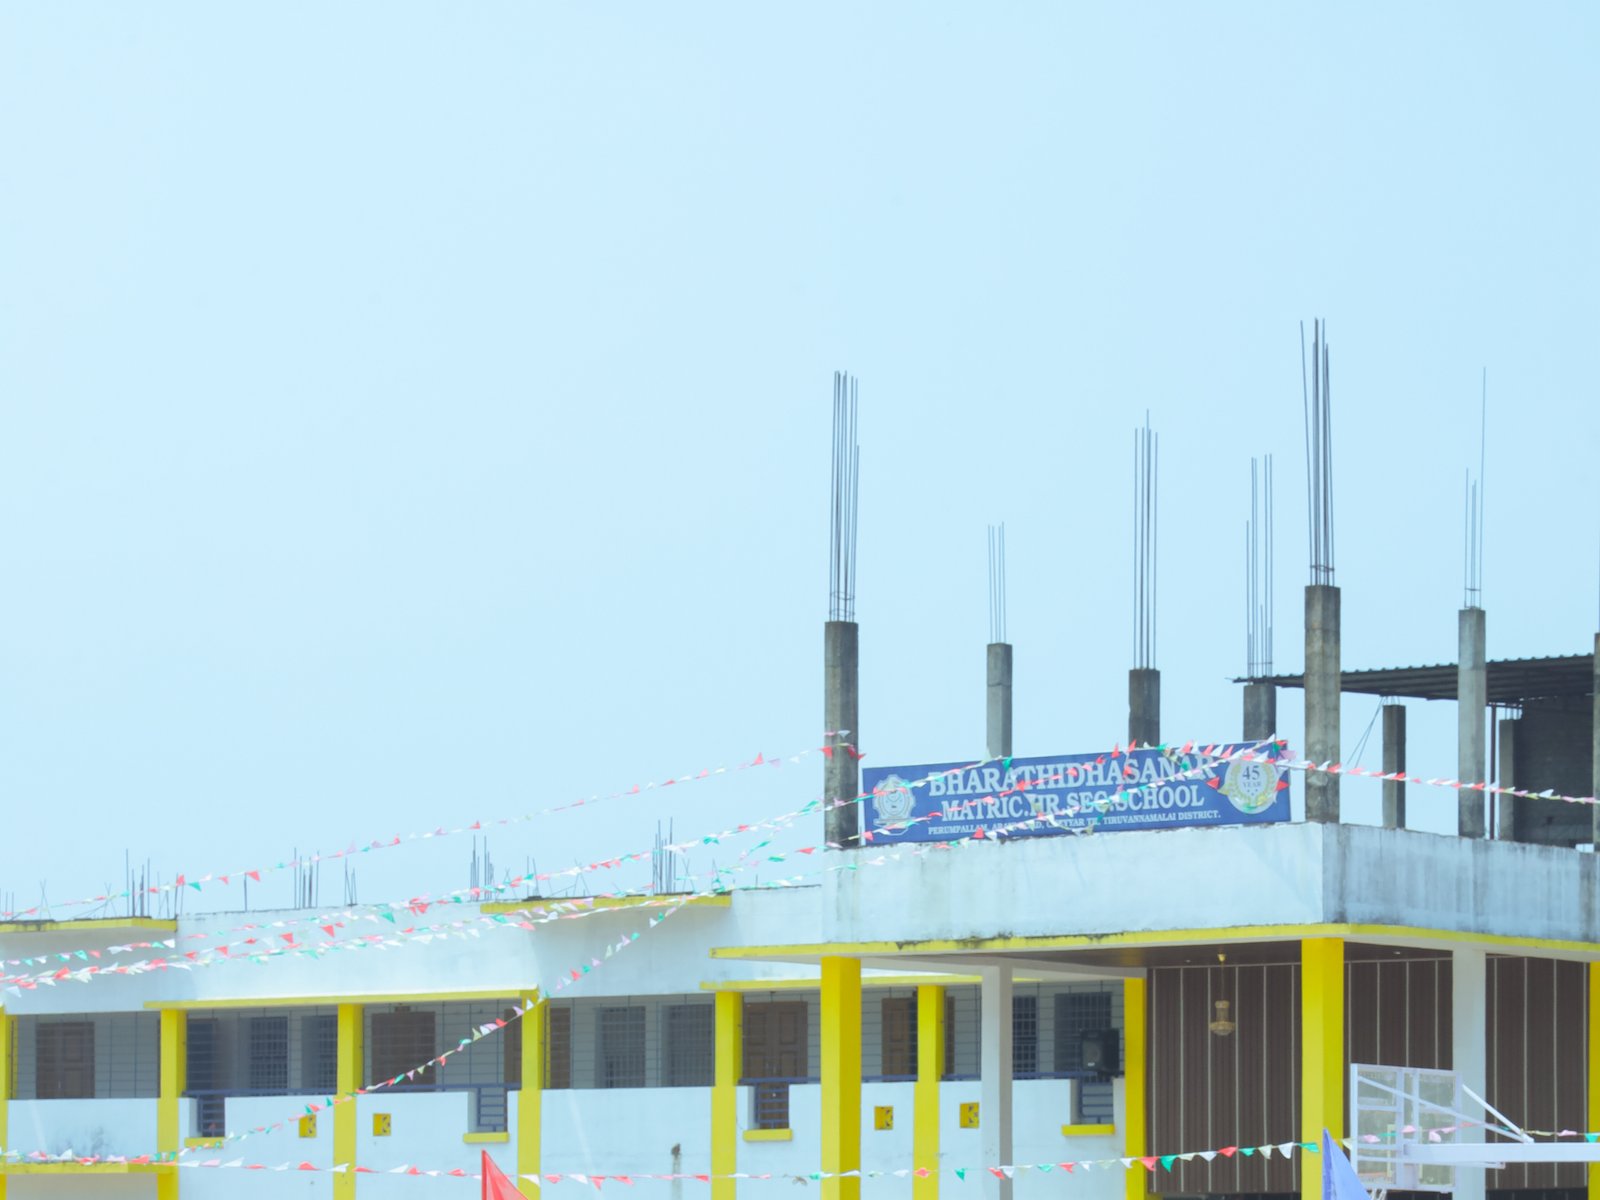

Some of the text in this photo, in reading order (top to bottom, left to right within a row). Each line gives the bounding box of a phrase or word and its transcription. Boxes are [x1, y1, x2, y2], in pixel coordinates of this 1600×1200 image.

[928, 755, 1217, 796] BHARATHIDHASANAR
[1242, 765, 1260, 780] 45
[1103, 812, 1176, 825] TIRUVANNAMALAI
[1178, 810, 1221, 820] DISTRICT.
